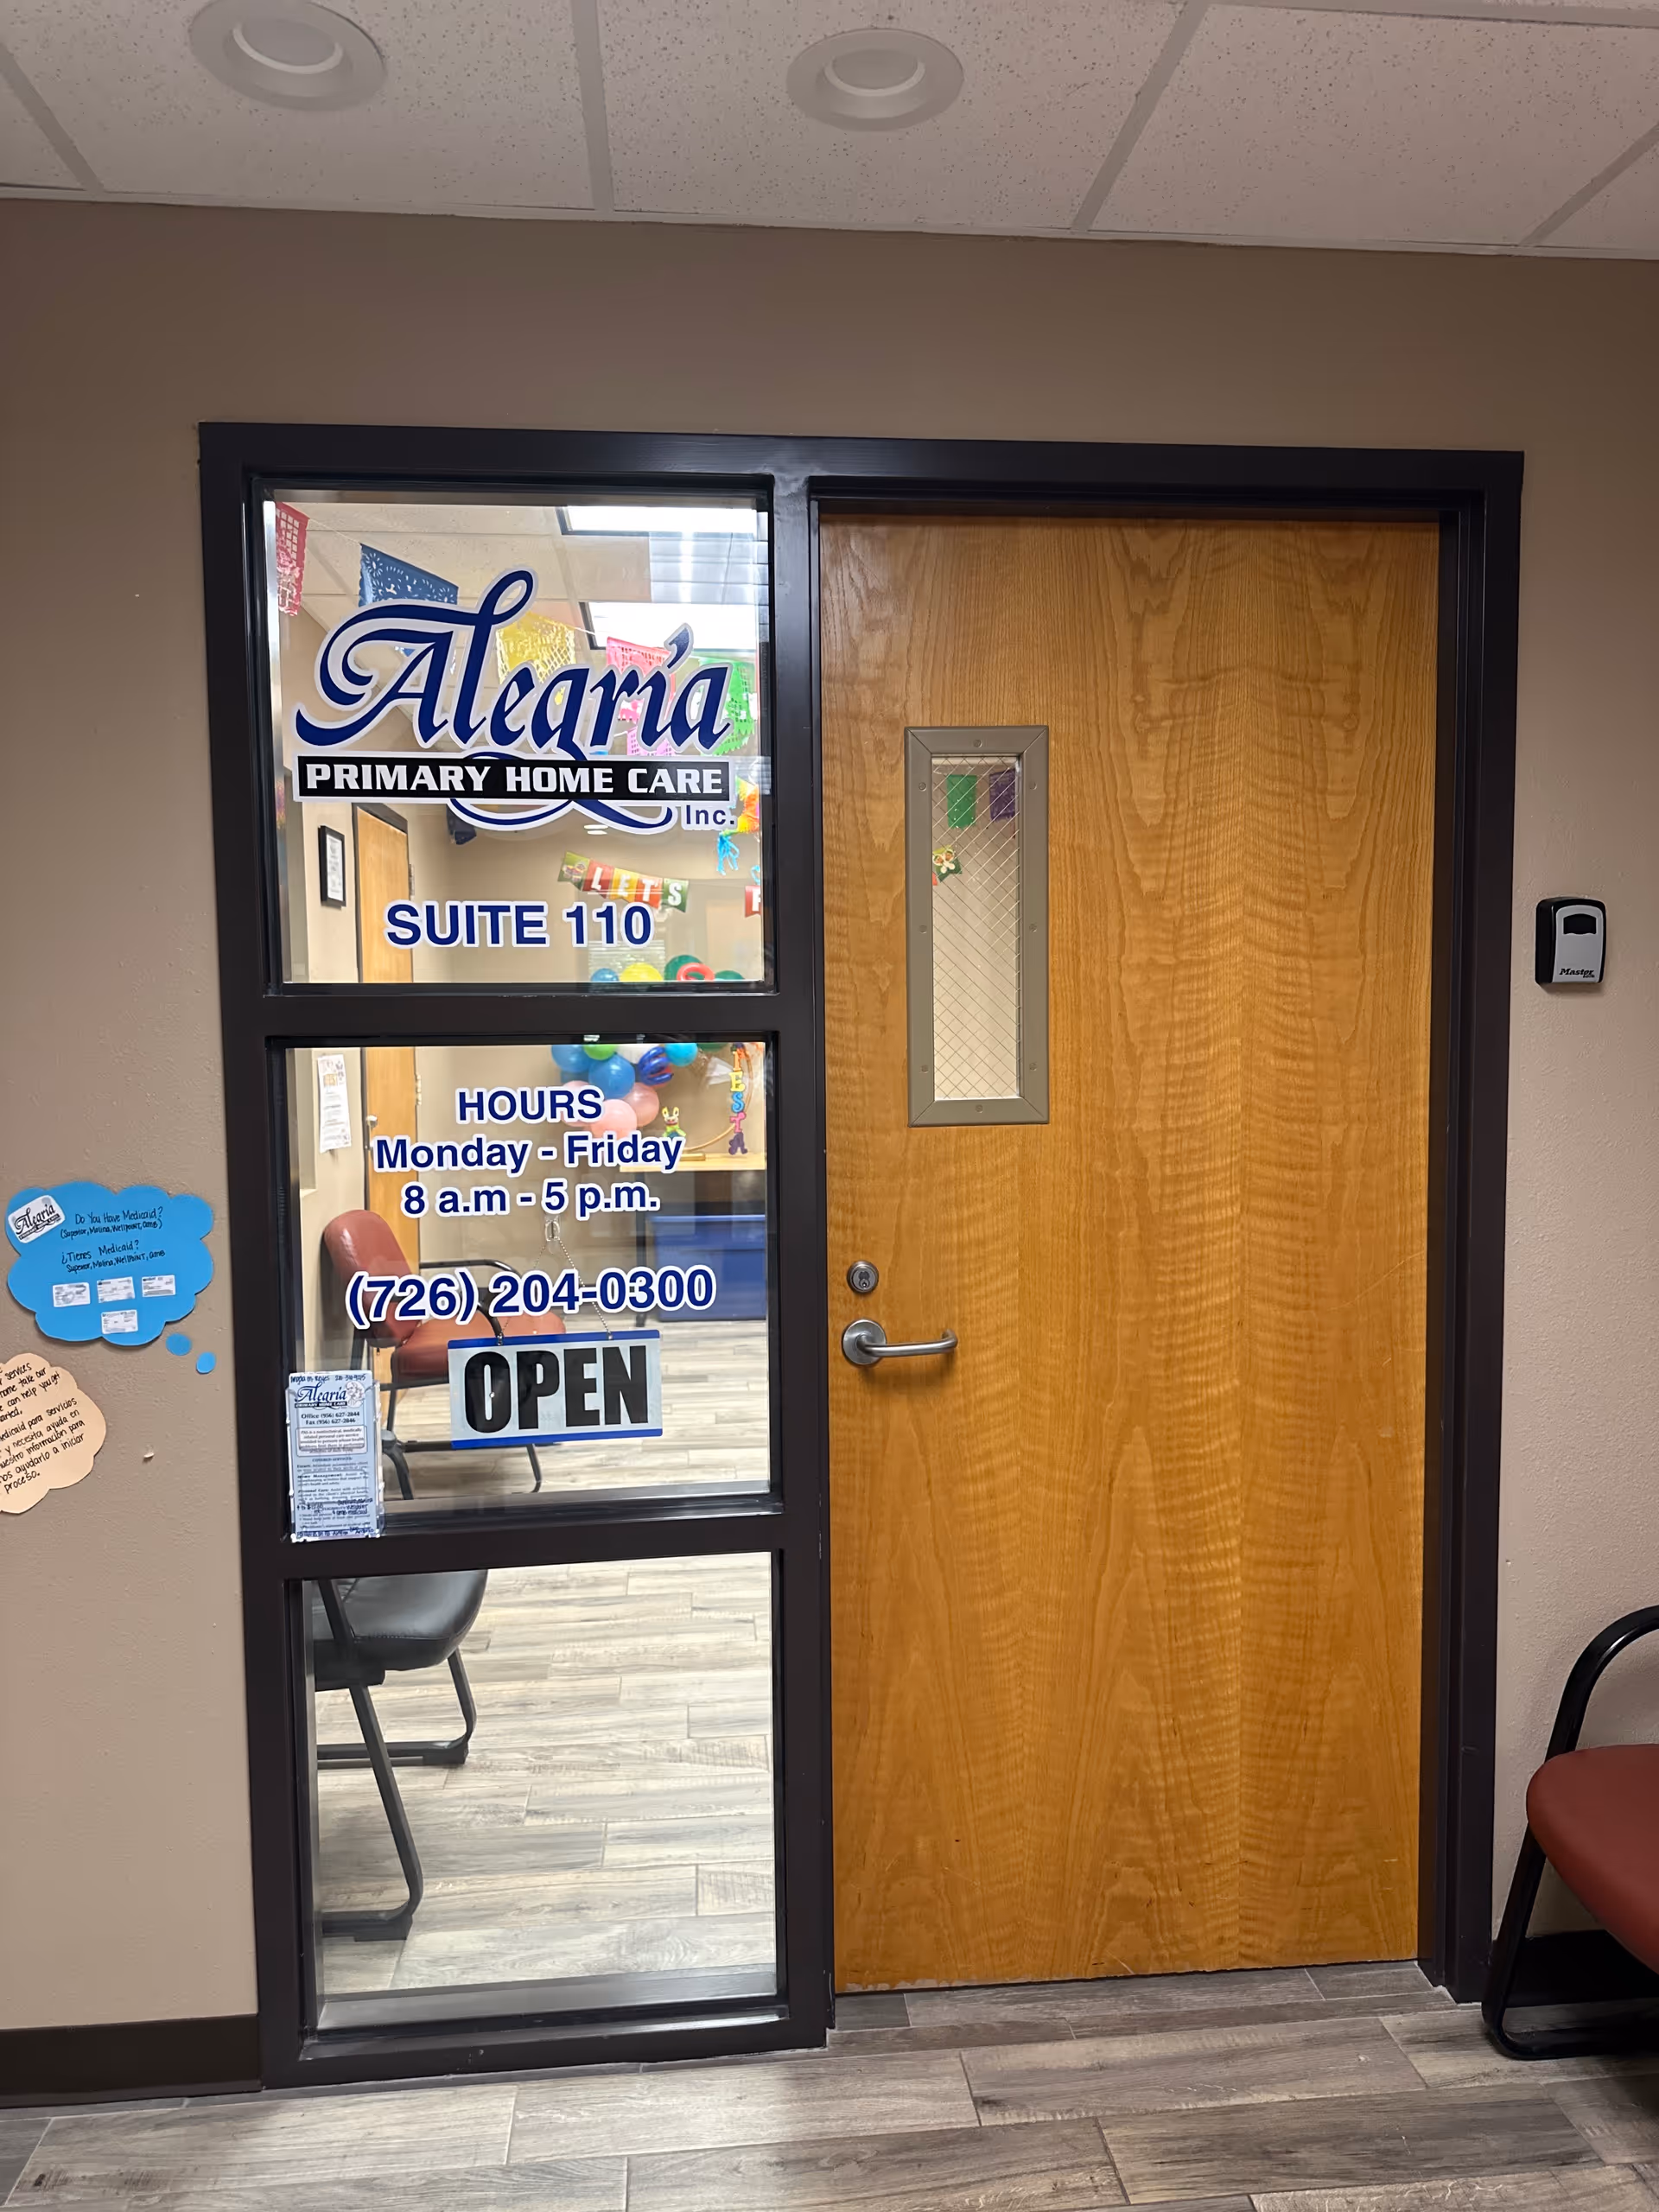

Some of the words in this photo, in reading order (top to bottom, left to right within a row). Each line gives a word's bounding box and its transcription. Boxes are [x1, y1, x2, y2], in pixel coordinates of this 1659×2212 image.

[295, 568, 738, 769] Alegría
[306, 764, 491, 792] PRIMARY
[505, 766, 613, 793] HOME
[627, 766, 723, 794] CARE
[685, 804, 736, 827] Inc.
[591, 867, 683, 906] LET'S
[386, 904, 548, 946] SUITE
[566, 905, 652, 946] 110
[1559, 968, 1594, 976] Master
[458, 1089, 603, 1122] HOURS
[377, 1137, 529, 1173] Monday
[568, 1134, 683, 1170] Friday
[403, 1185, 425, 1214] 8
[439, 1189, 508, 1213] a.m
[544, 1181, 566, 1211] 5
[579, 1185, 658, 1217] p.m.
[75, 1213, 86, 1224] Do
[87, 1211, 101, 1224] You
[103, 1211, 121, 1224] Have
[123, 1206, 163, 1220] Medicaid?
[98, 1239, 140, 1255] Medicaid?
[348, 1271, 475, 1326] (726)
[492, 1268, 714, 1313] 204-0300
[4, 1363, 33, 1381] services
[18, 1374, 35, 1388] take
[35, 1367, 47, 1378] our
[7, 1396, 22, 1408] can
[39, 1378, 52, 1392] you
[463, 1344, 650, 1434] OPEN
[0, 1407, 22, 1423] arted.
[0, 1421, 27, 1442] edicaid
[28, 1414, 43, 1430] para
[46, 1397, 78, 1417] servicios
[12, 1430, 44, 1448] necesita
[46, 1415, 69, 1433] ayuda
[69, 1409, 79, 1418] en
[68, 1420, 86, 1433] para
[52, 1446, 60, 1454] a
[60, 1433, 85, 1451] iniciar
[3, 1470, 41, 1495] proceso.
